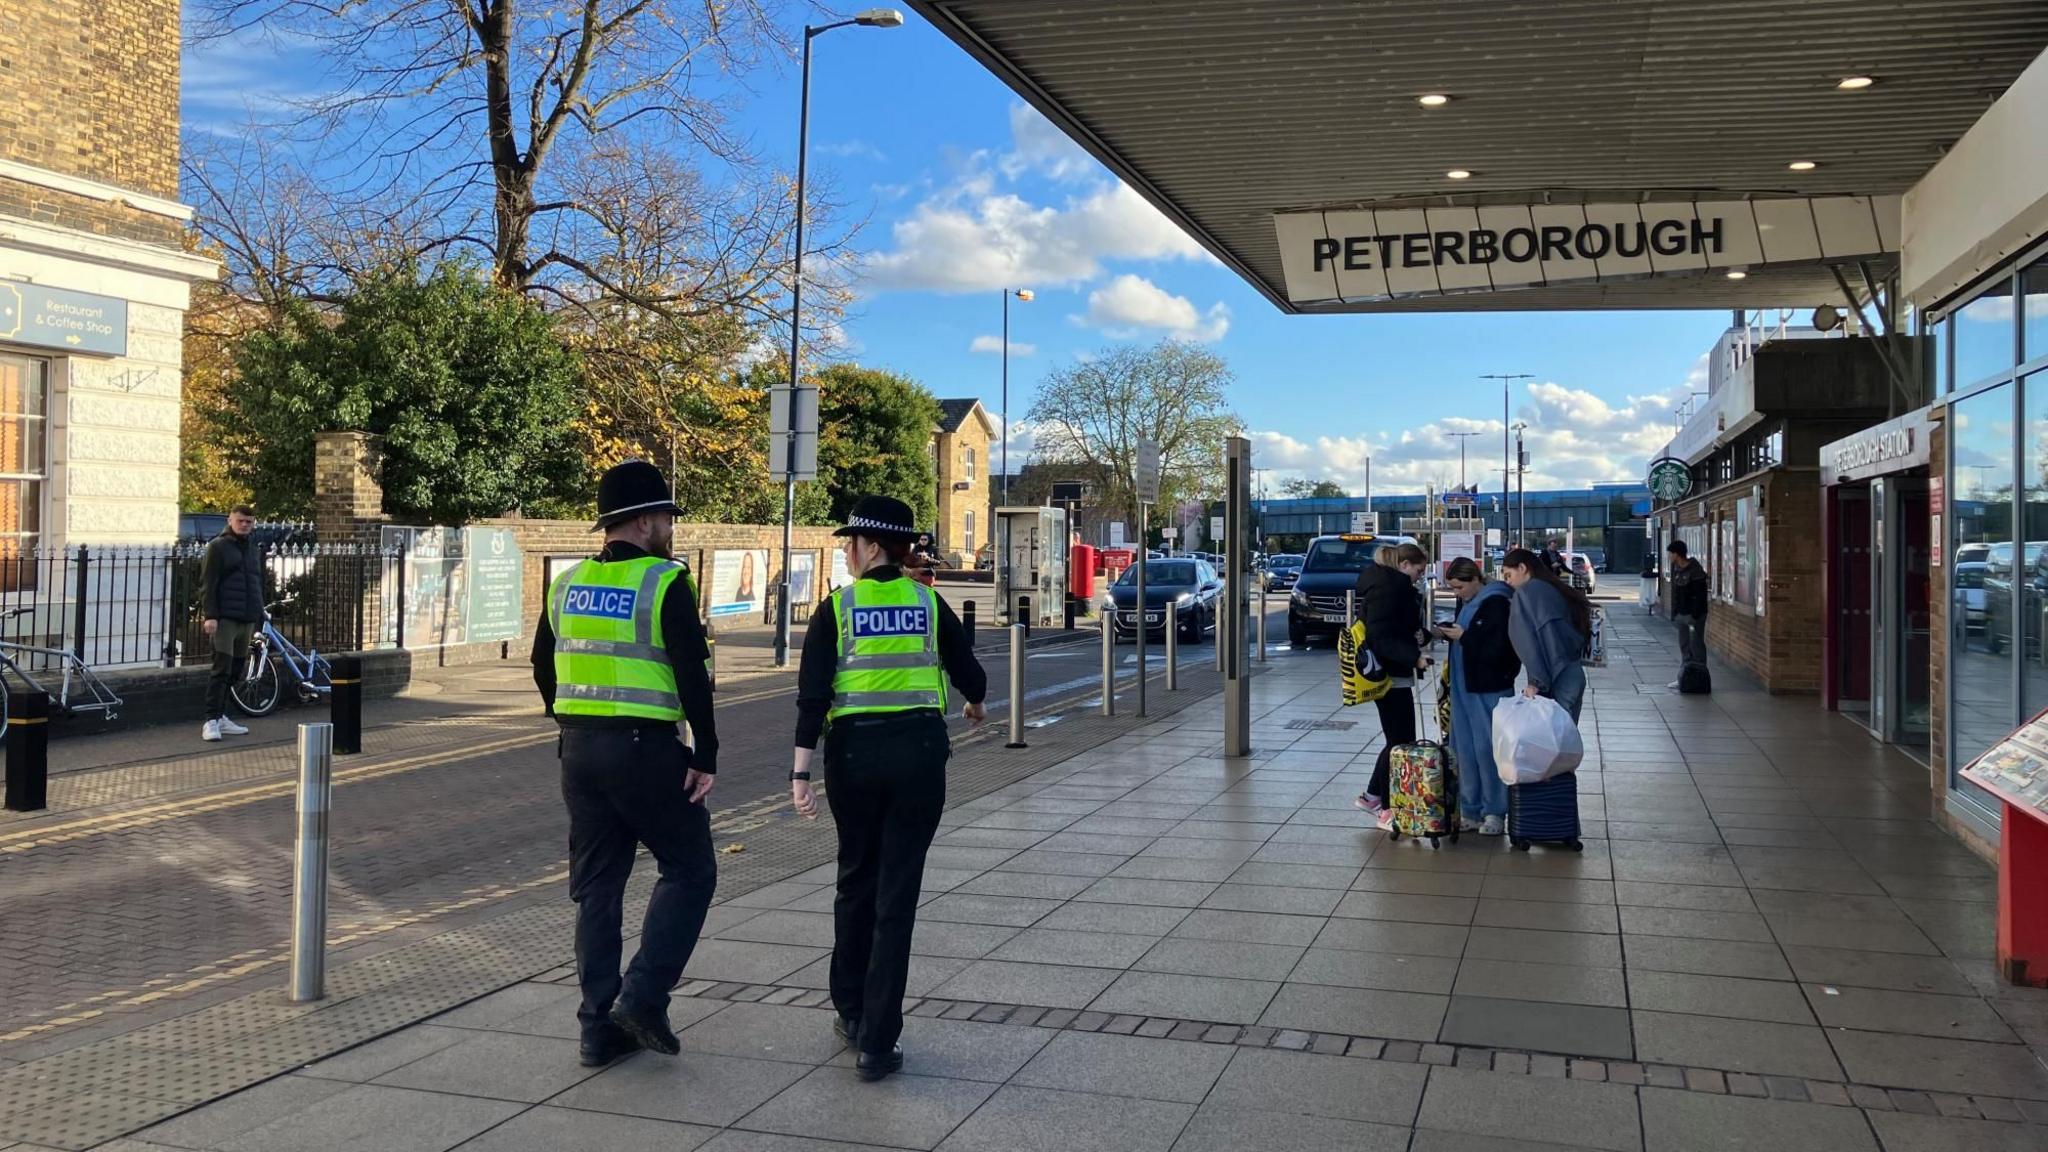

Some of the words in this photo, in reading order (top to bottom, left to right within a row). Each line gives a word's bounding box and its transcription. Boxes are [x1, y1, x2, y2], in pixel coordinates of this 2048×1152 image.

[1313, 217, 1723, 272] PETERBOROUGH
[46, 299, 103, 318] Restaurant
[35, 313, 44, 325] &
[47, 314, 83, 330] Coffee
[86, 320, 113, 335] Shop
[1834, 434, 1880, 473] PETERBOROUGH
[1880, 427, 1911, 460] STATION
[565, 589, 632, 615] POLICE
[855, 609, 926, 634] POLICE
